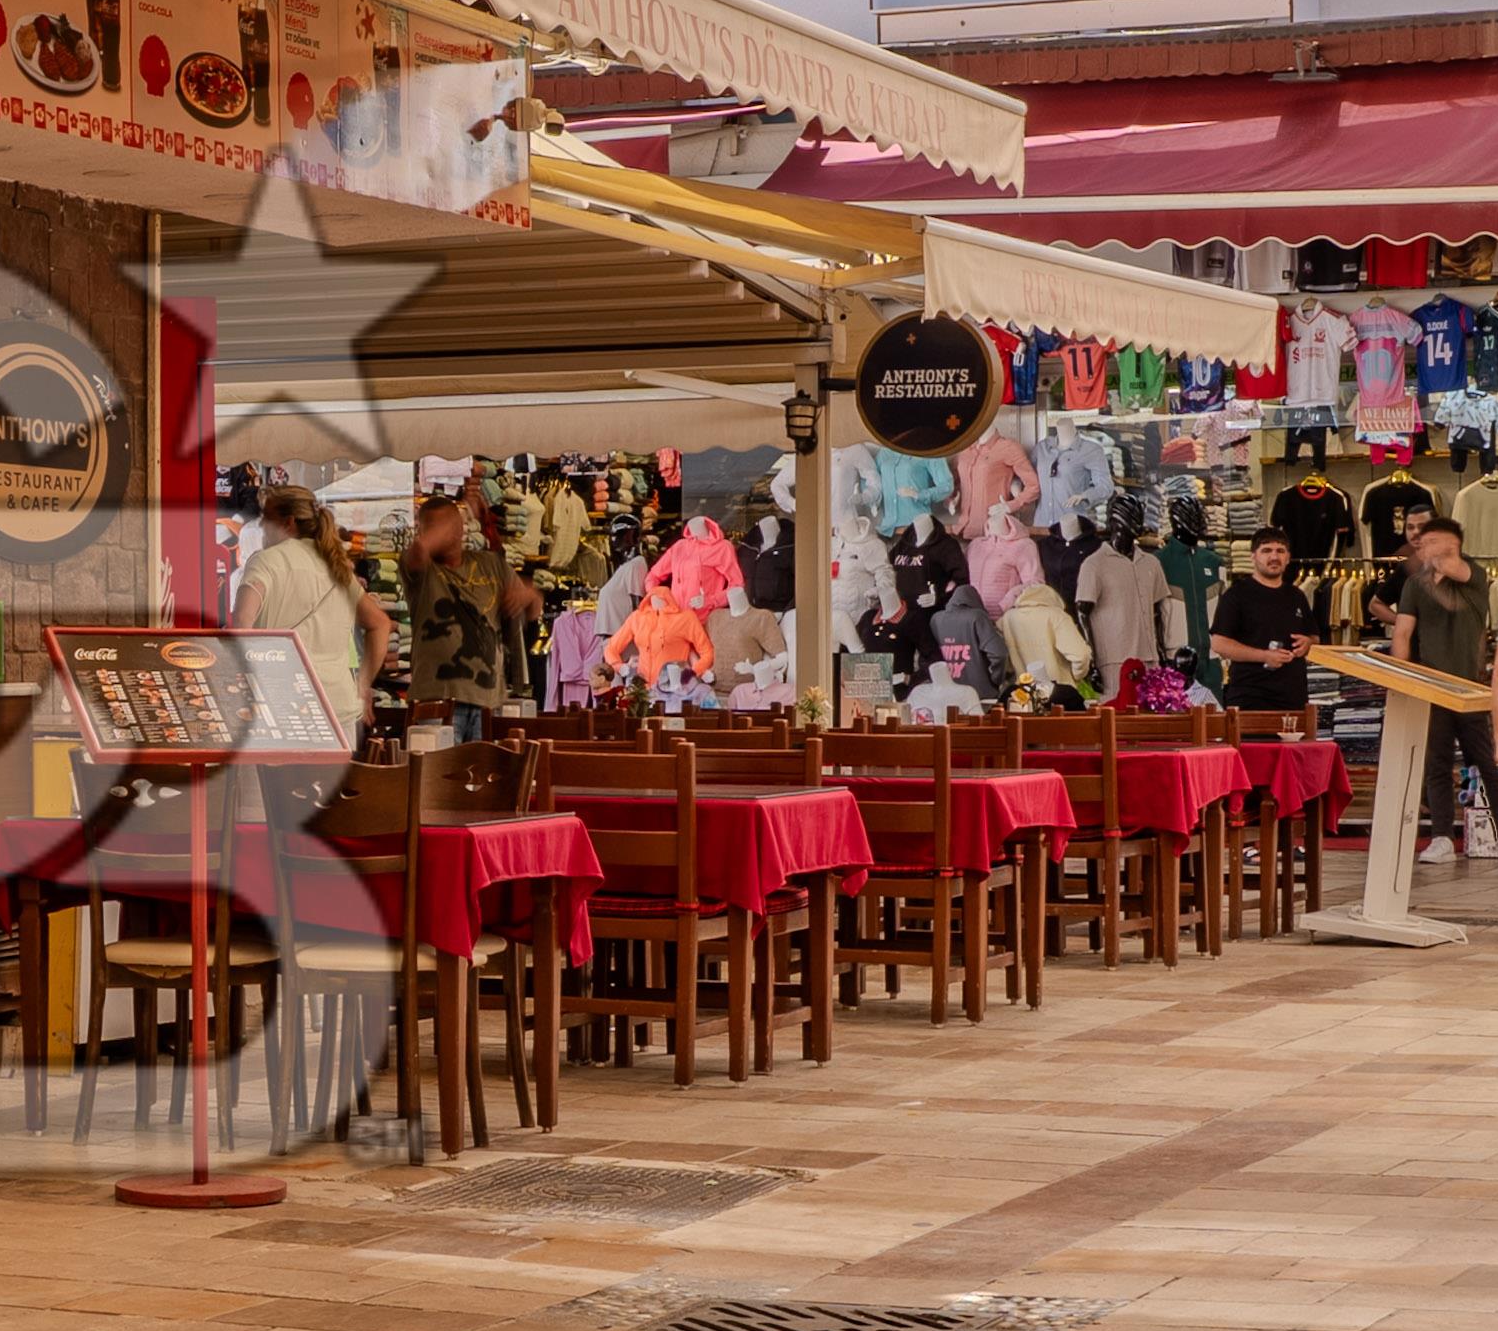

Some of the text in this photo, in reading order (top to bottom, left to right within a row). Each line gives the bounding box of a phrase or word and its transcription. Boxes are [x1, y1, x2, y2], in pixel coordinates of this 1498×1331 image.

[138, 1, 174, 18] COCA-COLA
[742, 27, 838, 117] DÖNER
[844, 73, 864, 125] &
[868, 79, 947, 152] KEBAP
[1424, 333, 1453, 368] 14
[1482, 335, 1495, 351] 17
[1067, 347, 1094, 380] 11
[881, 369, 970, 385] ANTHONY'S
[874, 383, 977, 399] RESTAURANT
[6, 494, 60, 513] & CAFE
[74, 648, 119, 662] Coca-Cola
[245, 649, 287, 663] Coca-Cola
